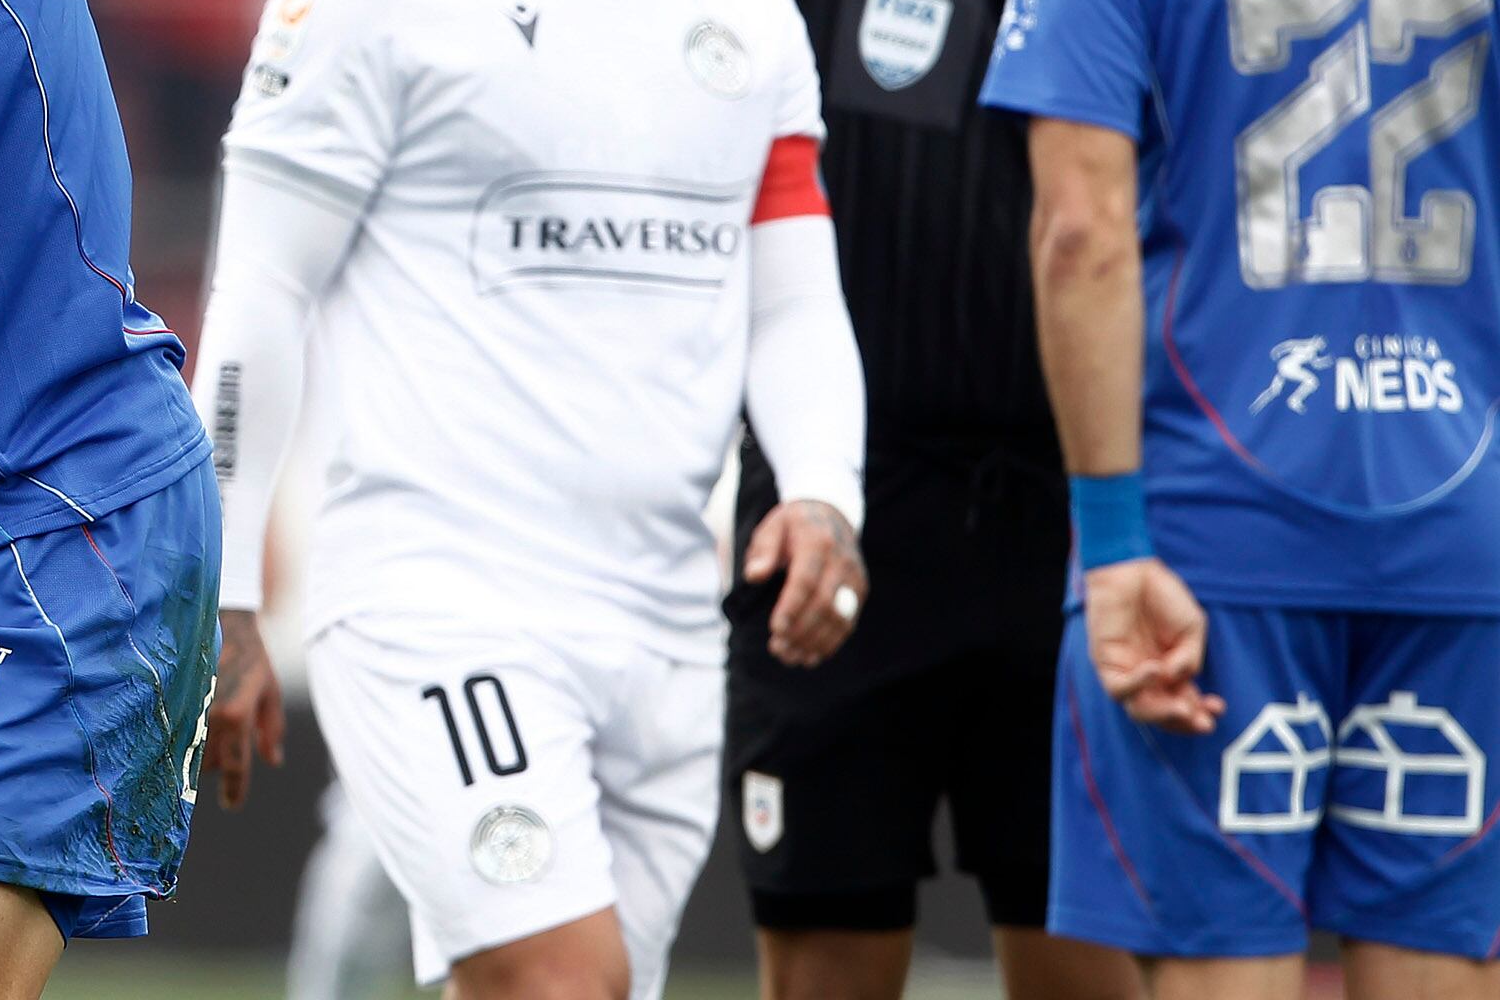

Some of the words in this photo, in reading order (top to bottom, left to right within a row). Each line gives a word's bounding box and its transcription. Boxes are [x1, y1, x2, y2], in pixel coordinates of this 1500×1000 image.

[504, 215, 741, 257] TRAVERSO
[1334, 356, 1464, 413] NEDS
[422, 673, 528, 786] 10
